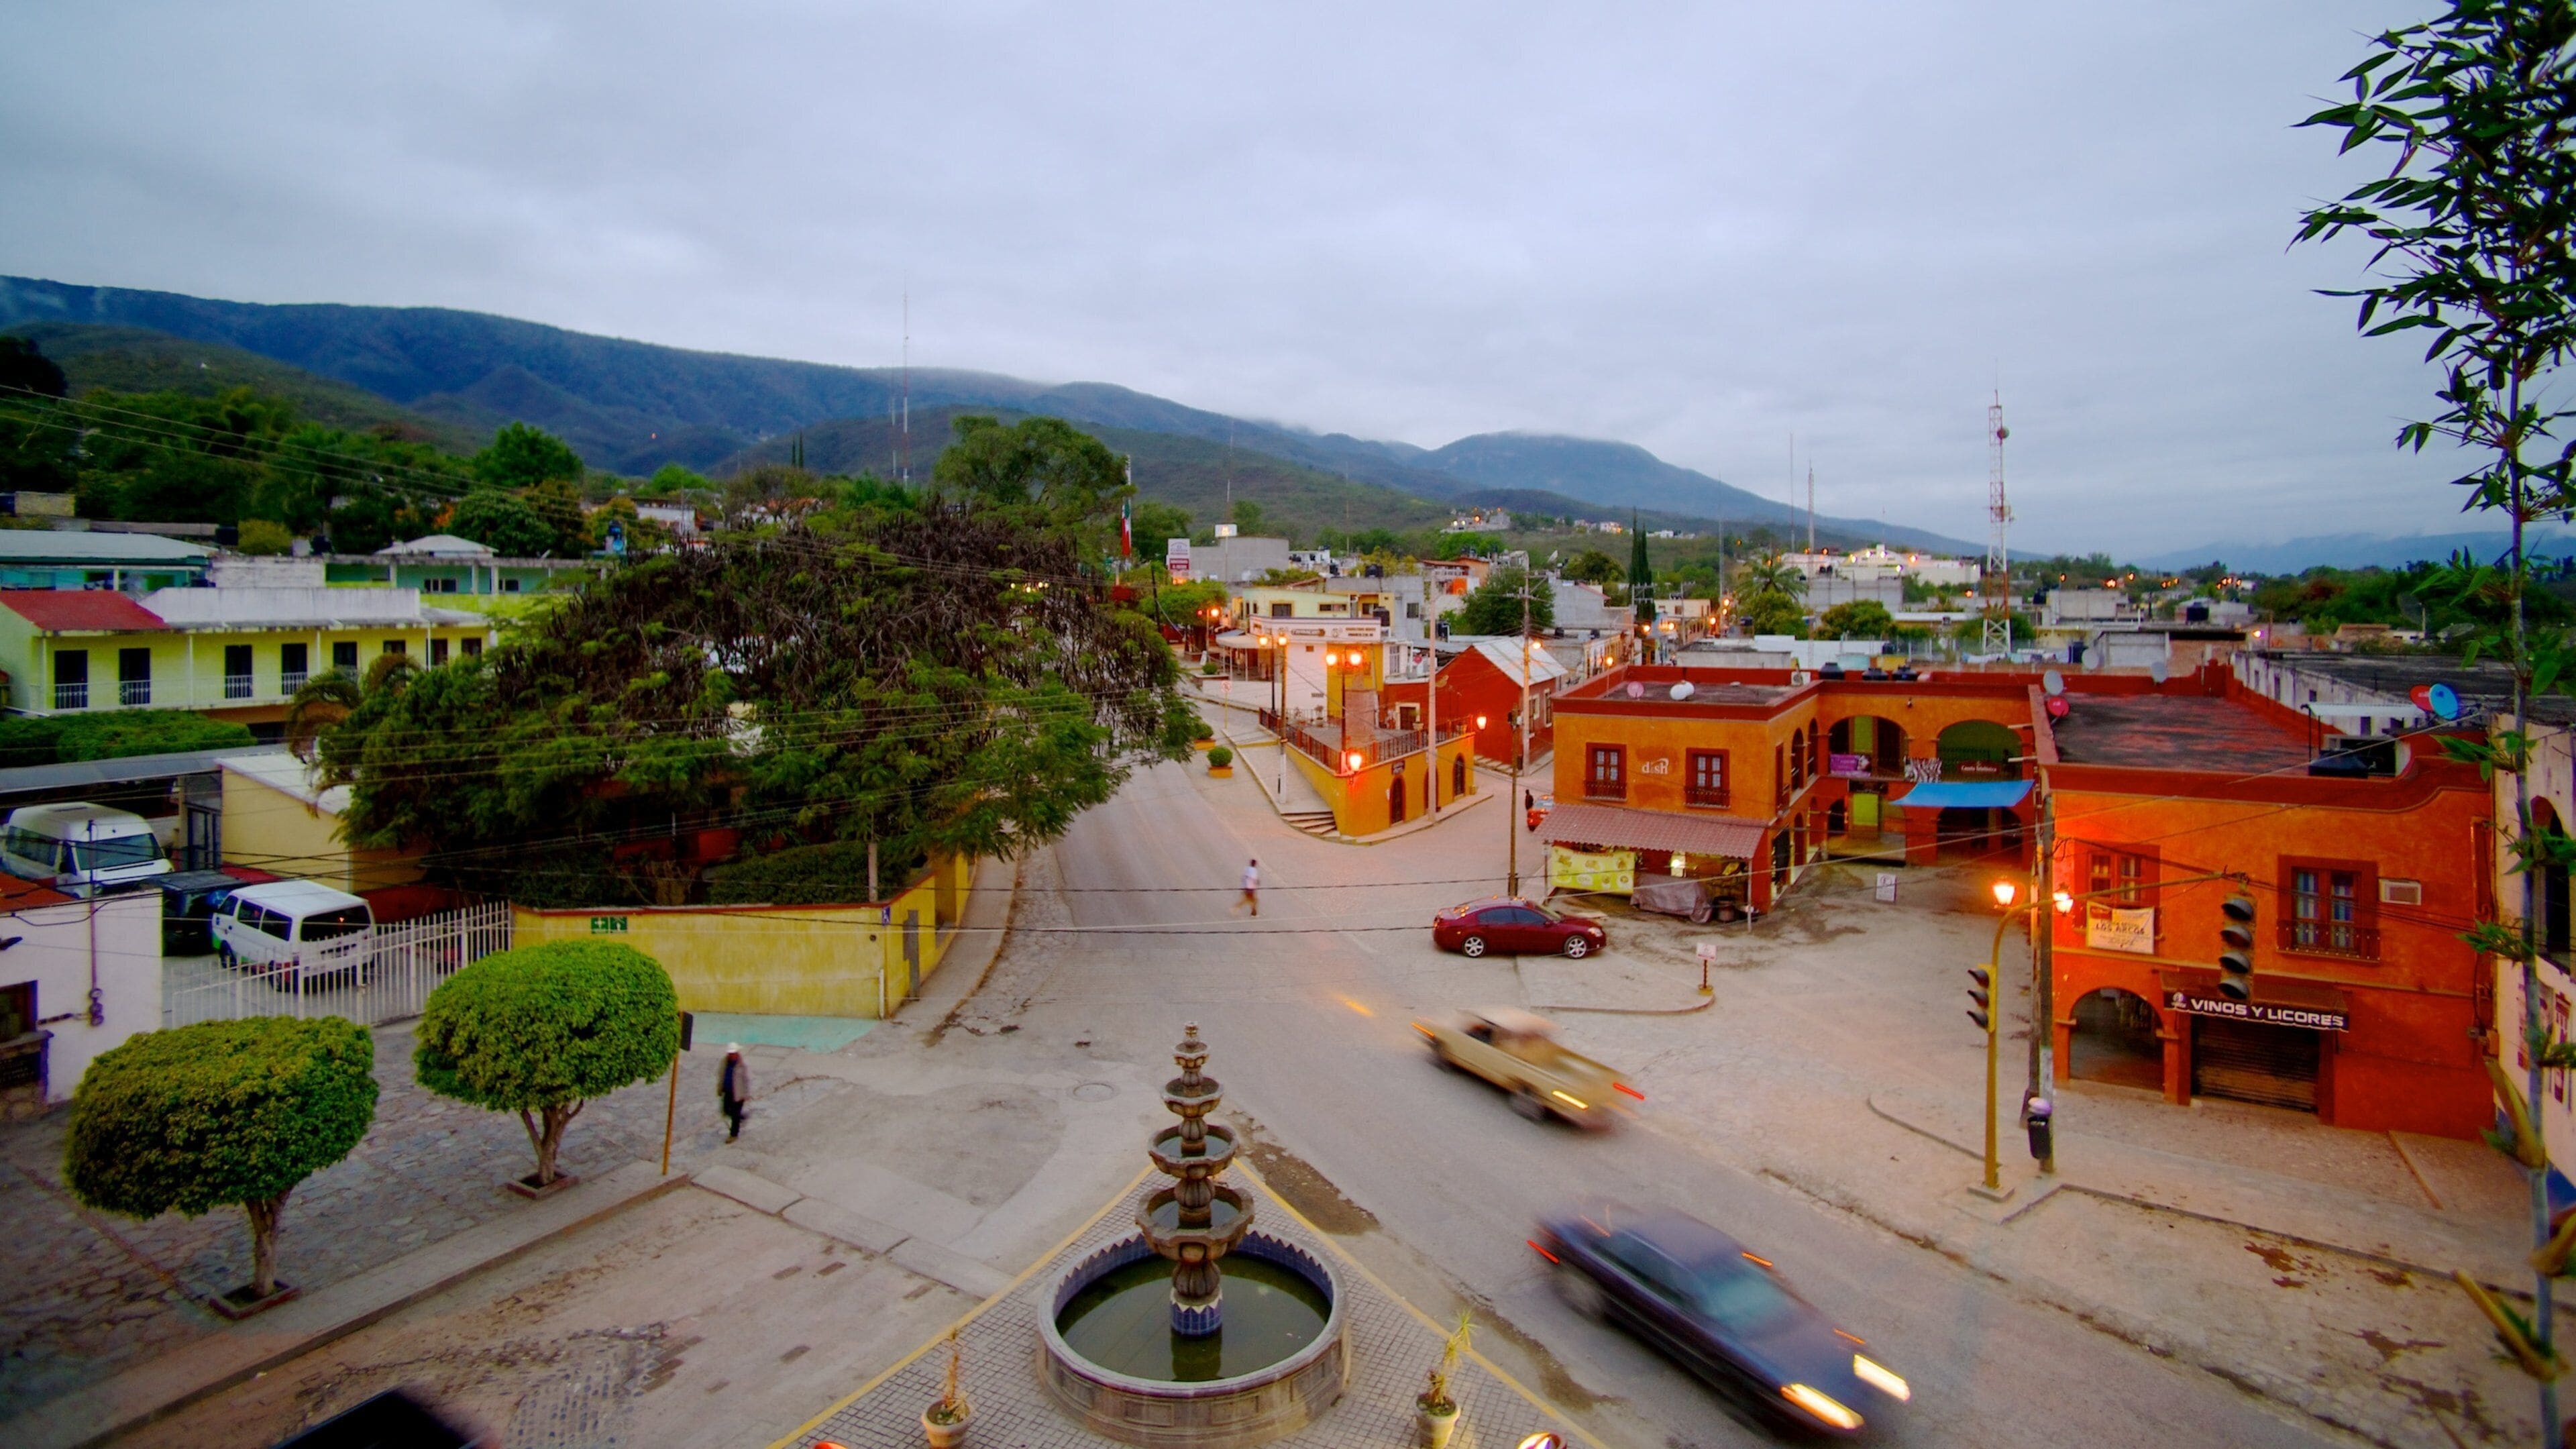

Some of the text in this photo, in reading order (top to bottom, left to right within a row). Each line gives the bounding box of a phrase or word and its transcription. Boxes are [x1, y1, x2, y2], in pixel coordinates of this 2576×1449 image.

[2190, 998, 2344, 1027] VINOS Y LICORES
